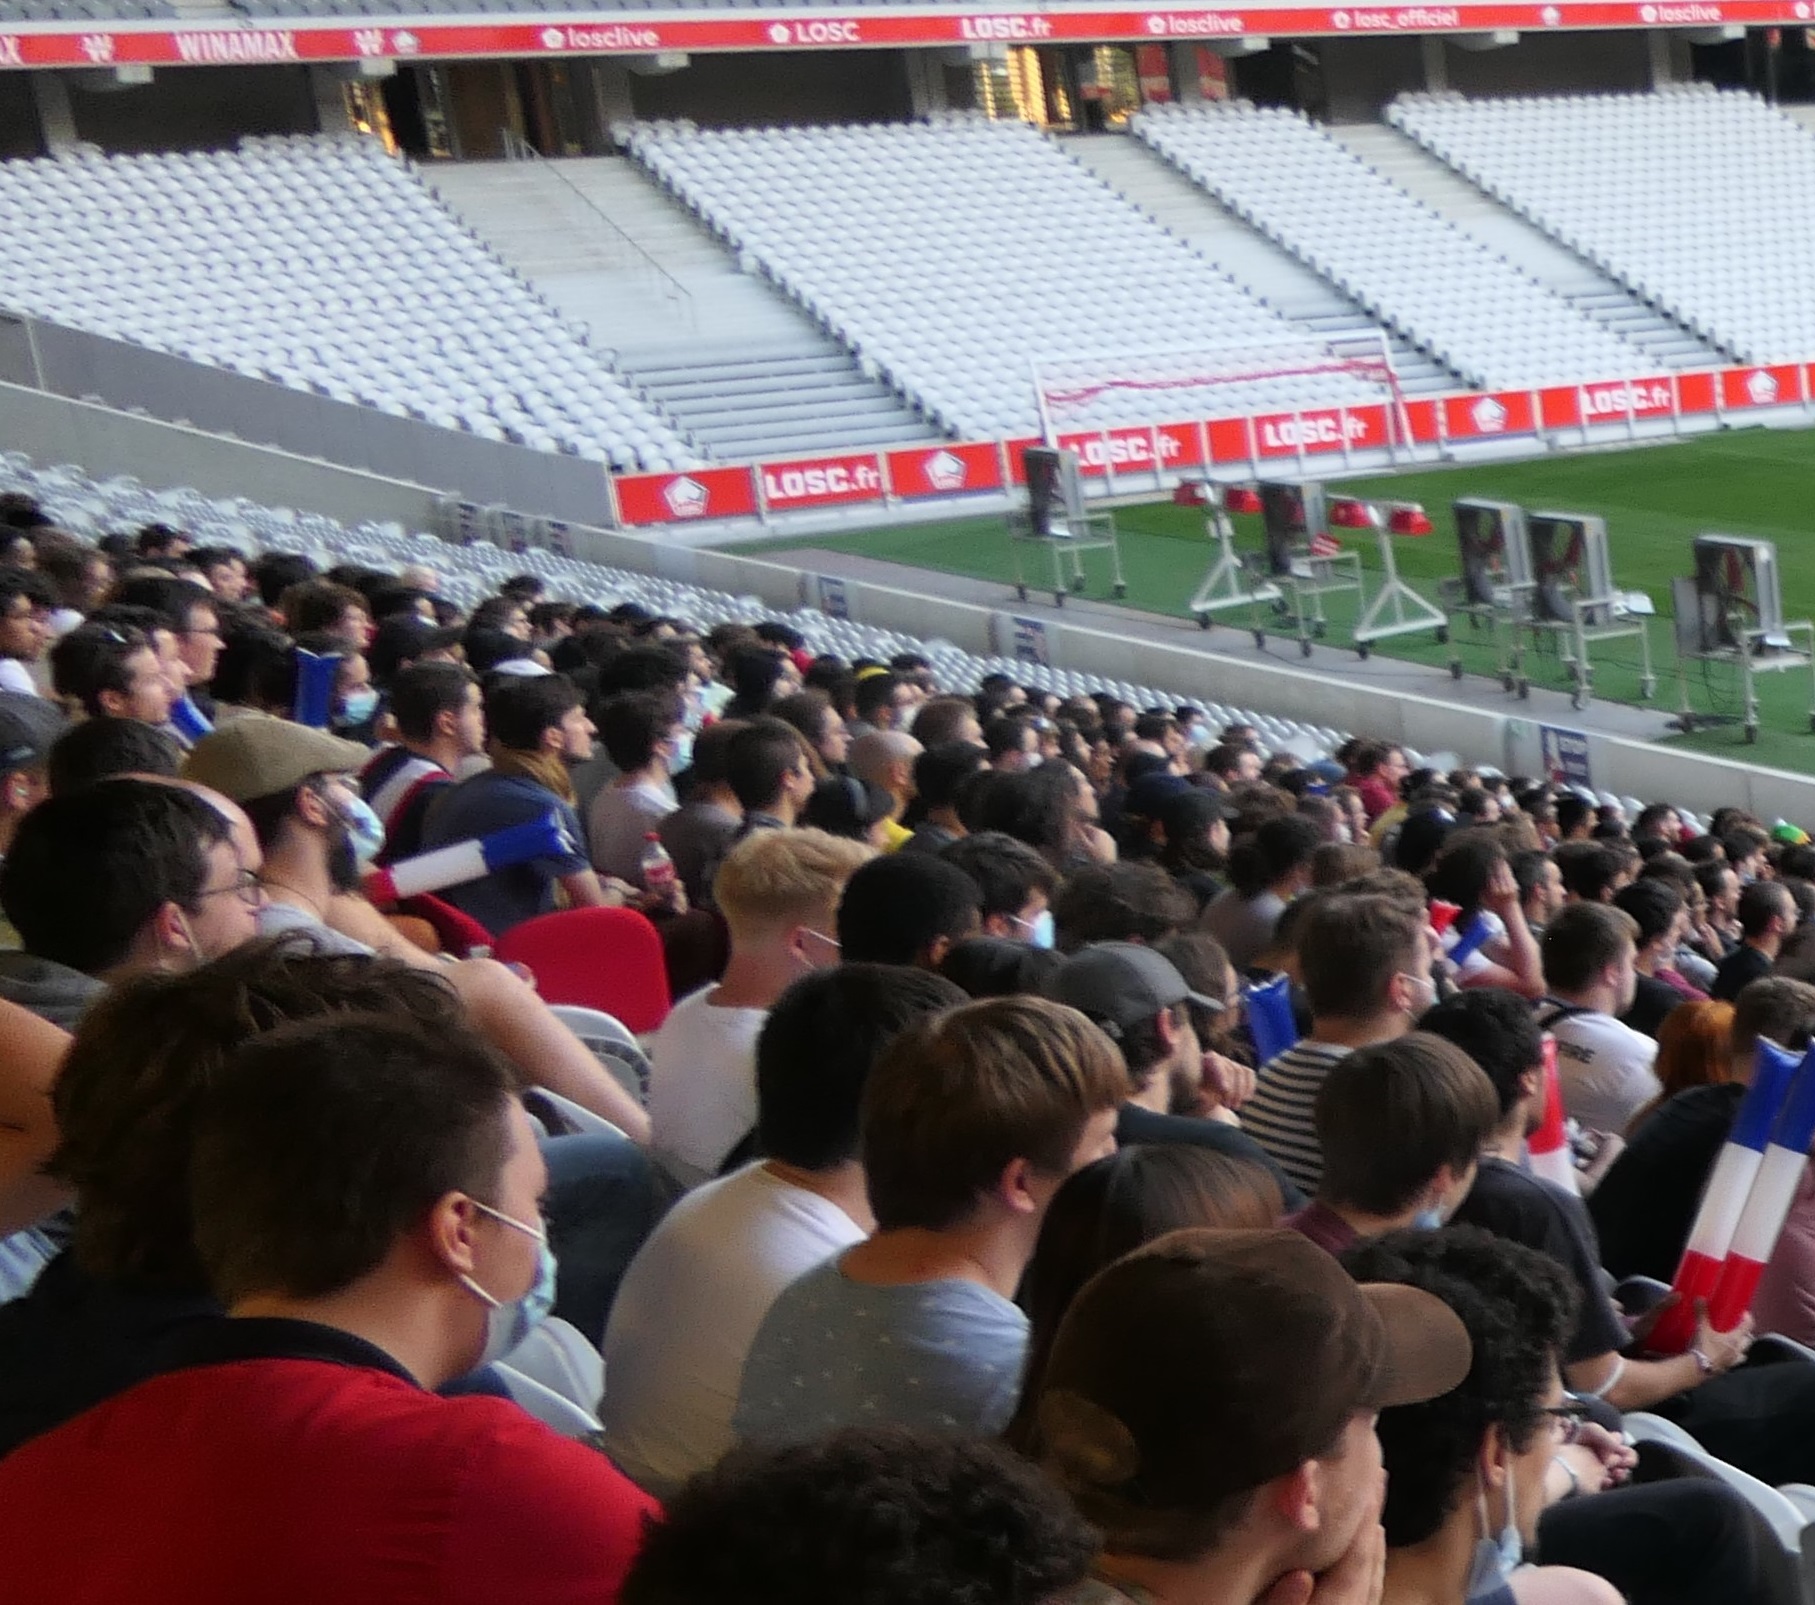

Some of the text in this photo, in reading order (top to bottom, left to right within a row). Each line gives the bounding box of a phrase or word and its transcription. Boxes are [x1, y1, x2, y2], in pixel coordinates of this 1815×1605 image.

[794, 21, 861, 43] LOSC
[961, 16, 1053, 41] LOSC.fr
[1168, 11, 1246, 35] losclive
[174, 33, 299, 62] WINAMAX
[567, 26, 660, 49] losclive
[1580, 385, 1671, 415] LOSC.fr
[1264, 415, 1367, 447] LOSC.fr
[763, 465, 883, 500] LOSC.fr
